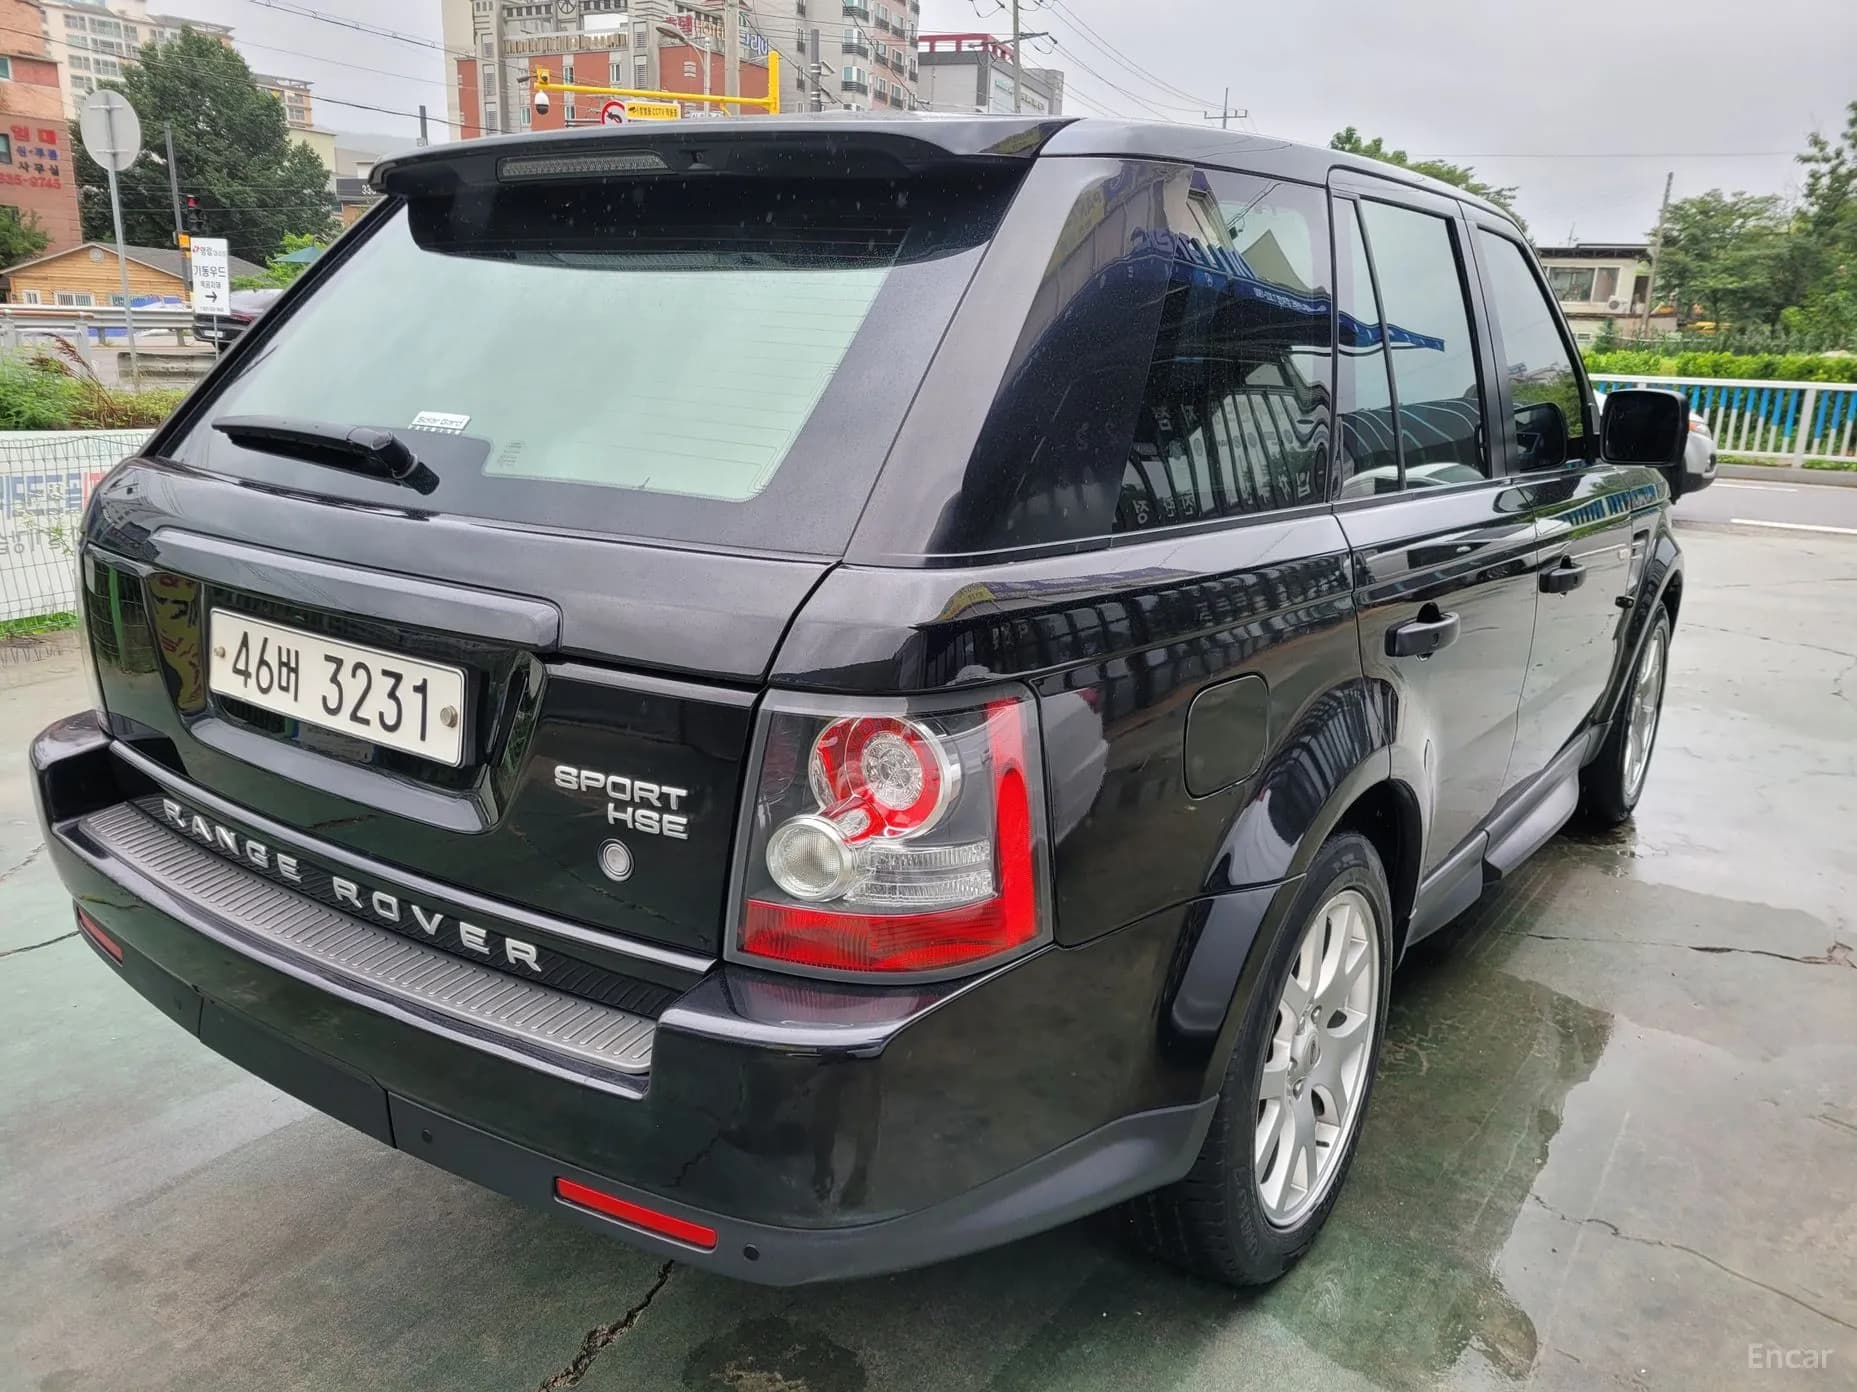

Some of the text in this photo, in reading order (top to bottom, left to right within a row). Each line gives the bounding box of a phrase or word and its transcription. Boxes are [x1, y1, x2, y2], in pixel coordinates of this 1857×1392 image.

[231, 630, 428, 742] 46버 3231
[554, 765, 688, 811] SPORT
[607, 802, 688, 840] HSE
[163, 798, 542, 972] RANGE ROVER
